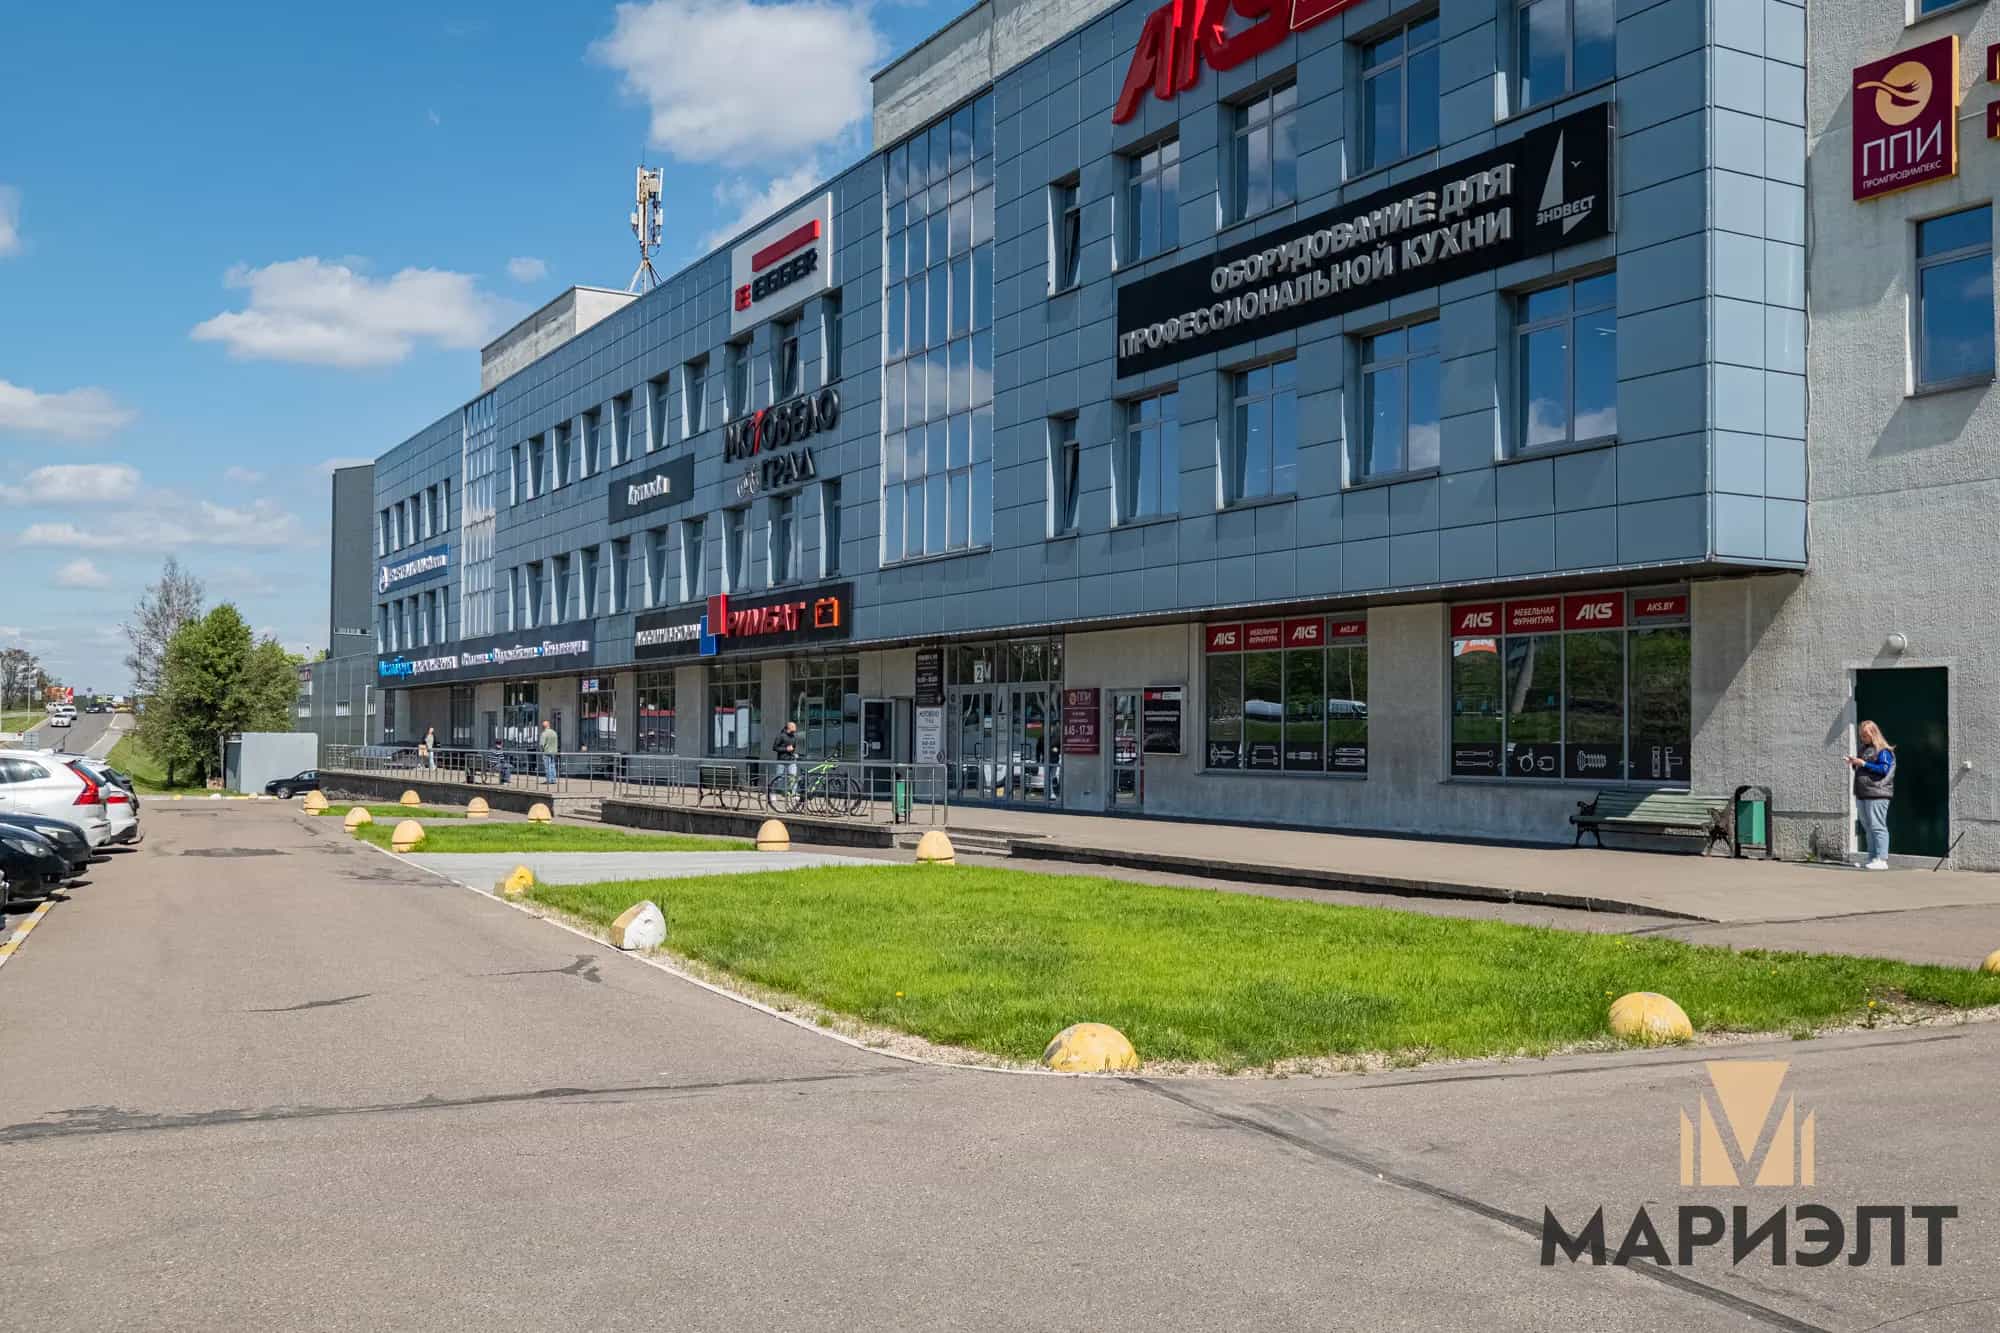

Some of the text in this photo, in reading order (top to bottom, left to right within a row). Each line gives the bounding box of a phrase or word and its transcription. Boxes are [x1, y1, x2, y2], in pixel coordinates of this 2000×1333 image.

[1863, 120, 1942, 176] ППИ
[1863, 160, 1942, 189] ПРОМПРОДИМПЕКС
[1211, 162, 1515, 293] ОБОРУДОВАНИЕ ДЛЯ
[1119, 207, 1511, 358] ПРОФЕССИОНАЛЬНОЙ КУХНИ
[723, 389, 840, 464] МОТОВЕЛО
[1461, 611, 1494, 629] AKS
[1513, 605, 1555, 616] МЕБЕЛЬНАЯ
[1575, 602, 1614, 621] AKS
[1512, 615, 1554, 626] ФУРНИТУРА
[1212, 631, 1236, 646] AKS
[1292, 625, 1318, 640] AKS
